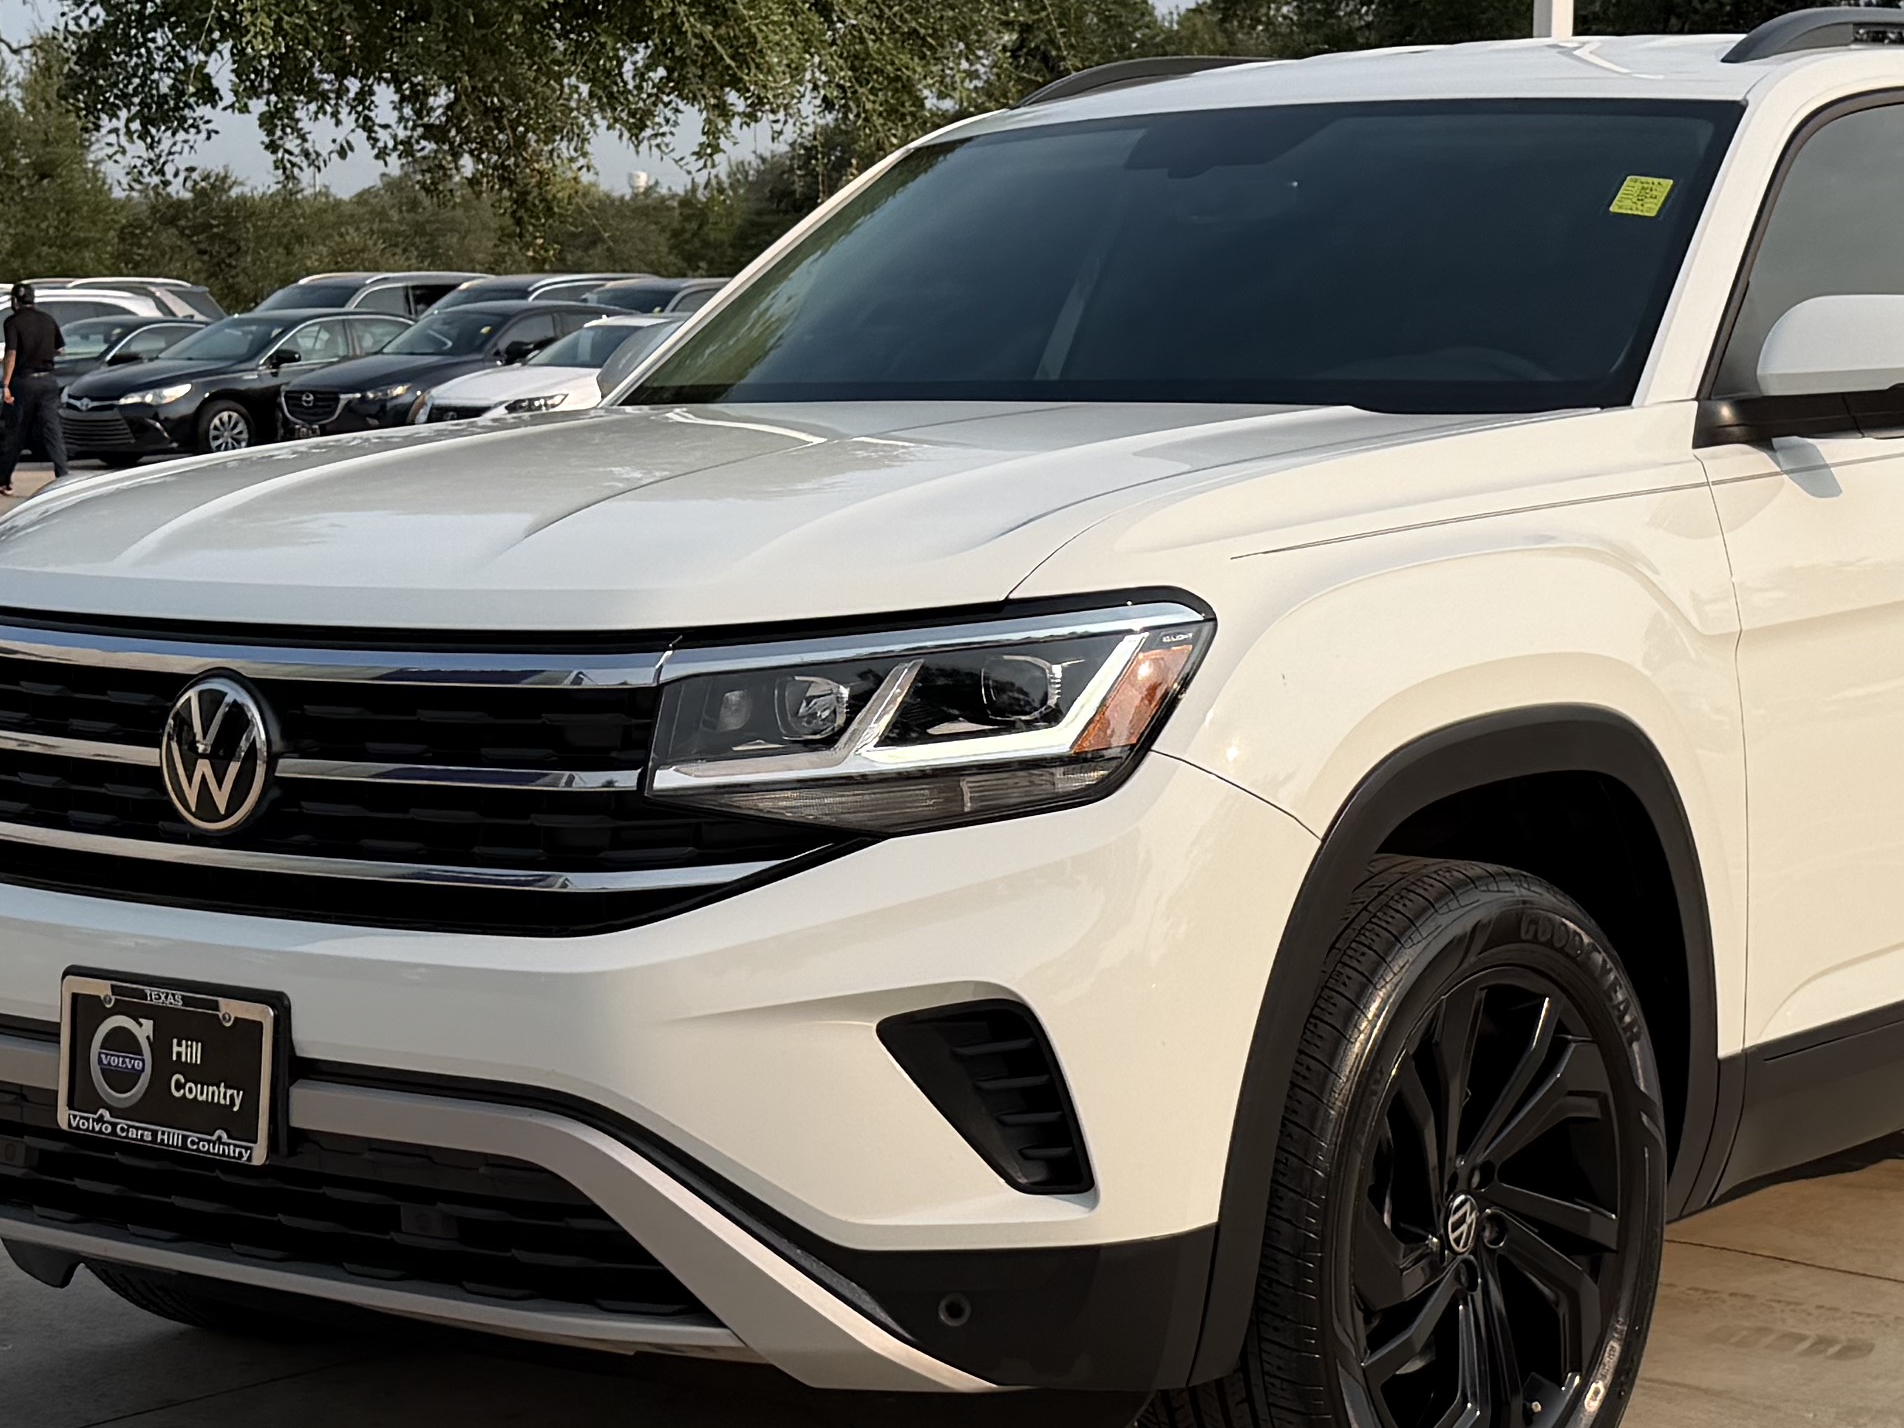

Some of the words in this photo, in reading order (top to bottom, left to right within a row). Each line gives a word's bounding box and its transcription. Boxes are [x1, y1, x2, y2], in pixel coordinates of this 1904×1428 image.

[145, 989, 183, 1007] TEXAS
[100, 1053, 143, 1070] VOLVO
[171, 1037, 202, 1065] Hill
[170, 1073, 244, 1112] Country
[69, 1113, 112, 1135] Volvo
[116, 1123, 152, 1142] Cars
[157, 1129, 182, 1148] Hill
[187, 1136, 251, 1162] Country
